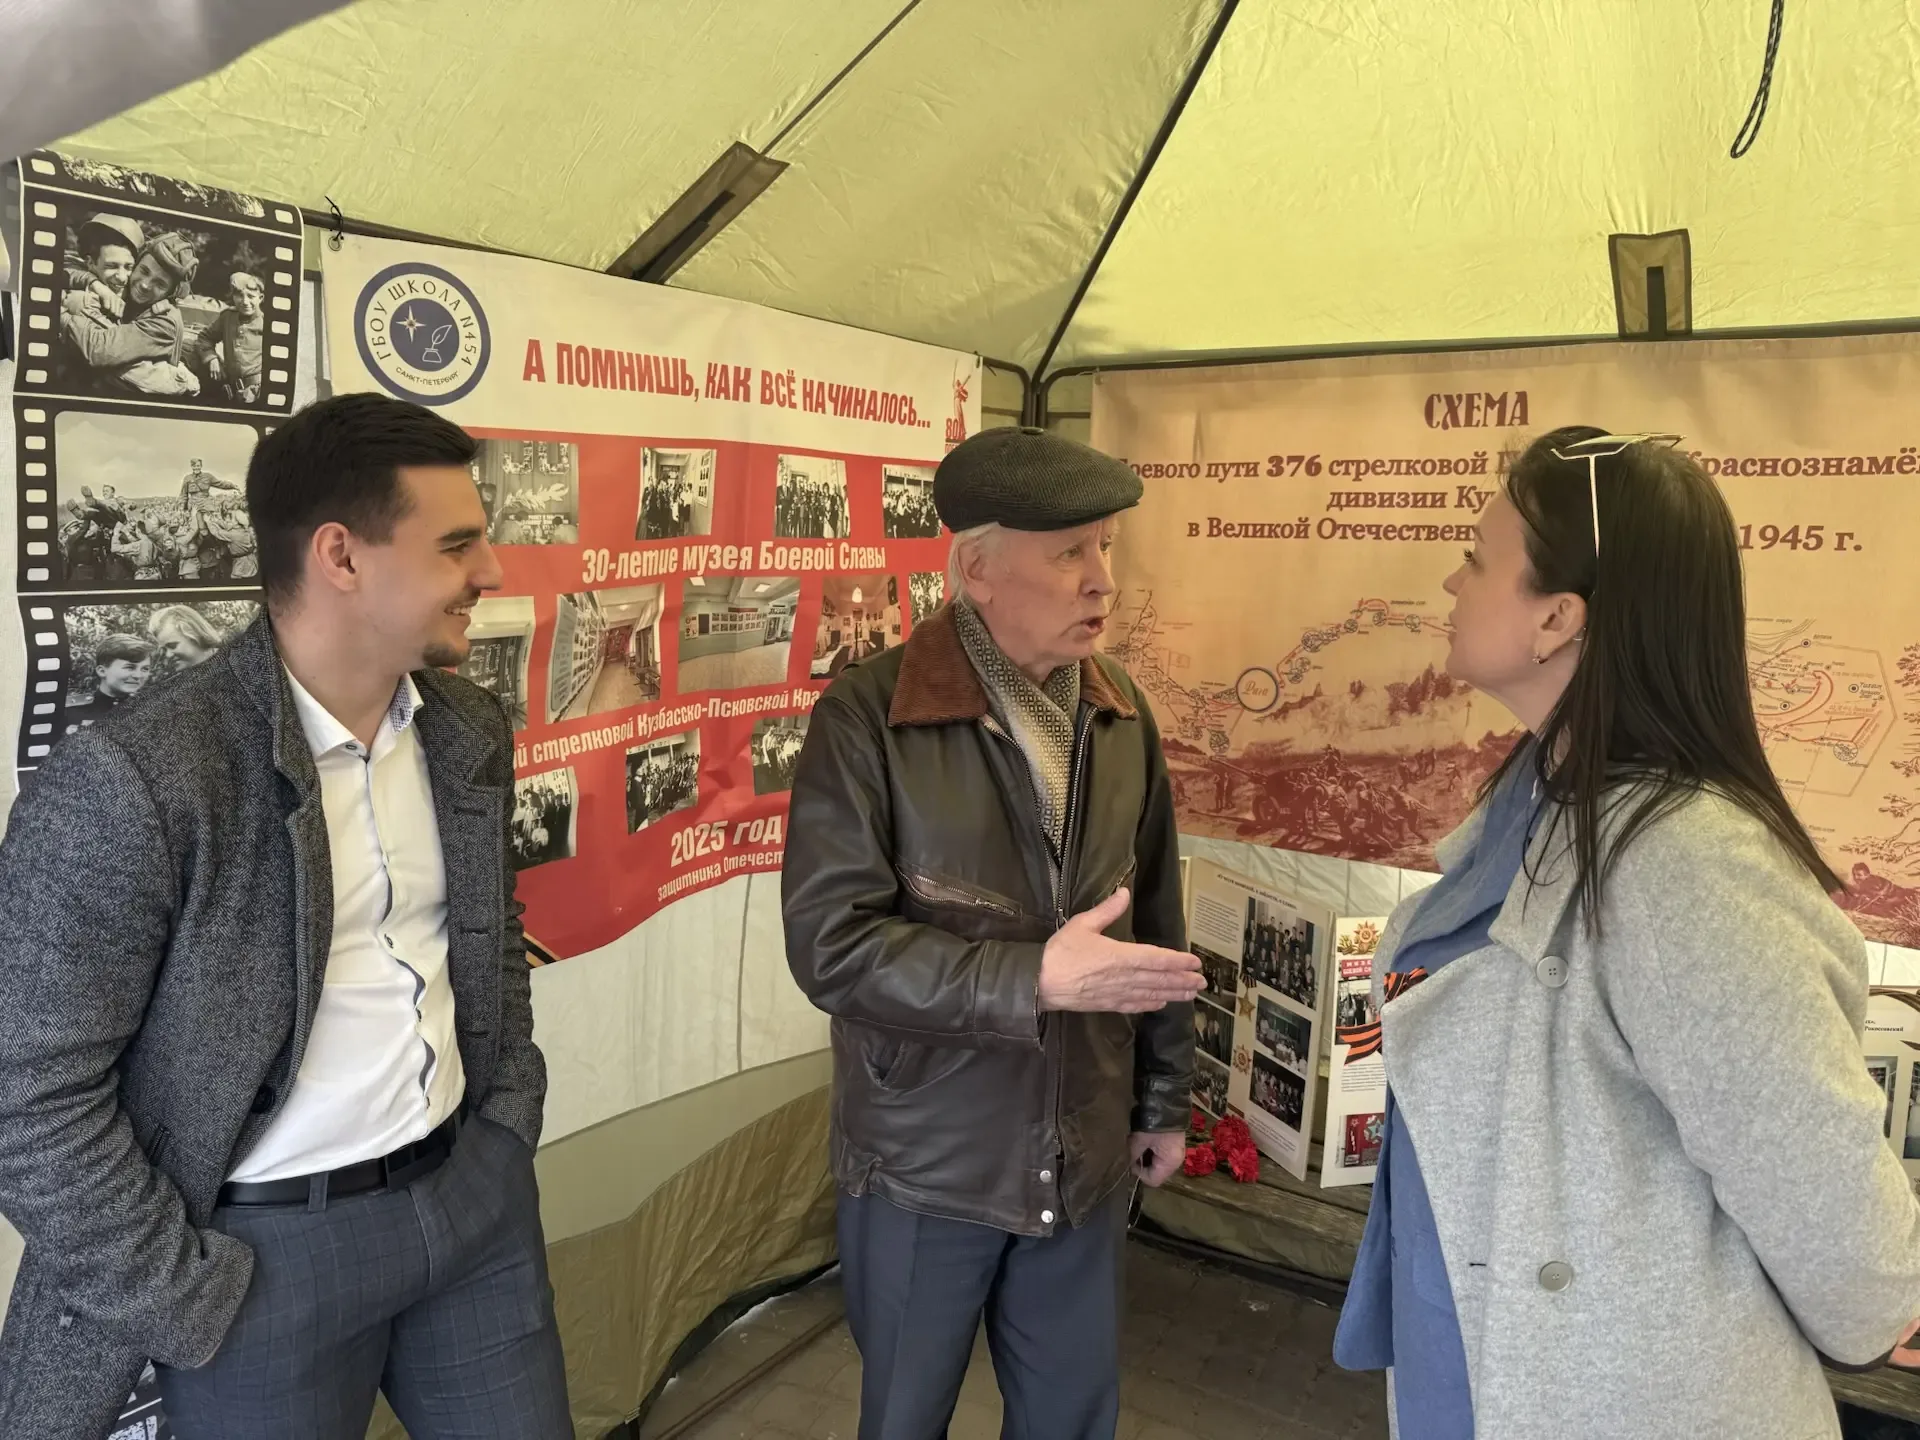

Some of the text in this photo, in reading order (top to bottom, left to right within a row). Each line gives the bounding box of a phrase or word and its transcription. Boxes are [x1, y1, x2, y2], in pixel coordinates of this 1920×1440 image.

[370, 301, 391, 360] ГБОУ
[388, 279, 461, 311] ШКОЛА
[396, 367, 459, 386] САНКТ-ПЕТЕРБУРГ
[522, 339, 931, 429] А ПОМНИШЬ, КАК ВСЁ НАЧИНАЛОСЬ...
[1424, 391, 1530, 431] СХЕМА
[1119, 458, 1201, 479] оевого
[1205, 462, 1260, 484] пути
[1266, 455, 1322, 478] 376
[1328, 451, 1489, 482] стрелковой
[1686, 447, 1920, 477] раснознамё
[1326, 491, 1448, 512] дивизии
[1187, 524, 1200, 538] в
[1206, 517, 1310, 540] Великой
[1738, 524, 1863, 551] 1945 г.
[582, 541, 887, 584] 30-летие музея Боевой Славы
[532, 716, 635, 764] стрелковой
[637, 690, 789, 738] Кузбасско-Псковской
[670, 815, 782, 868] 2025 год
[657, 862, 722, 902] защитника
